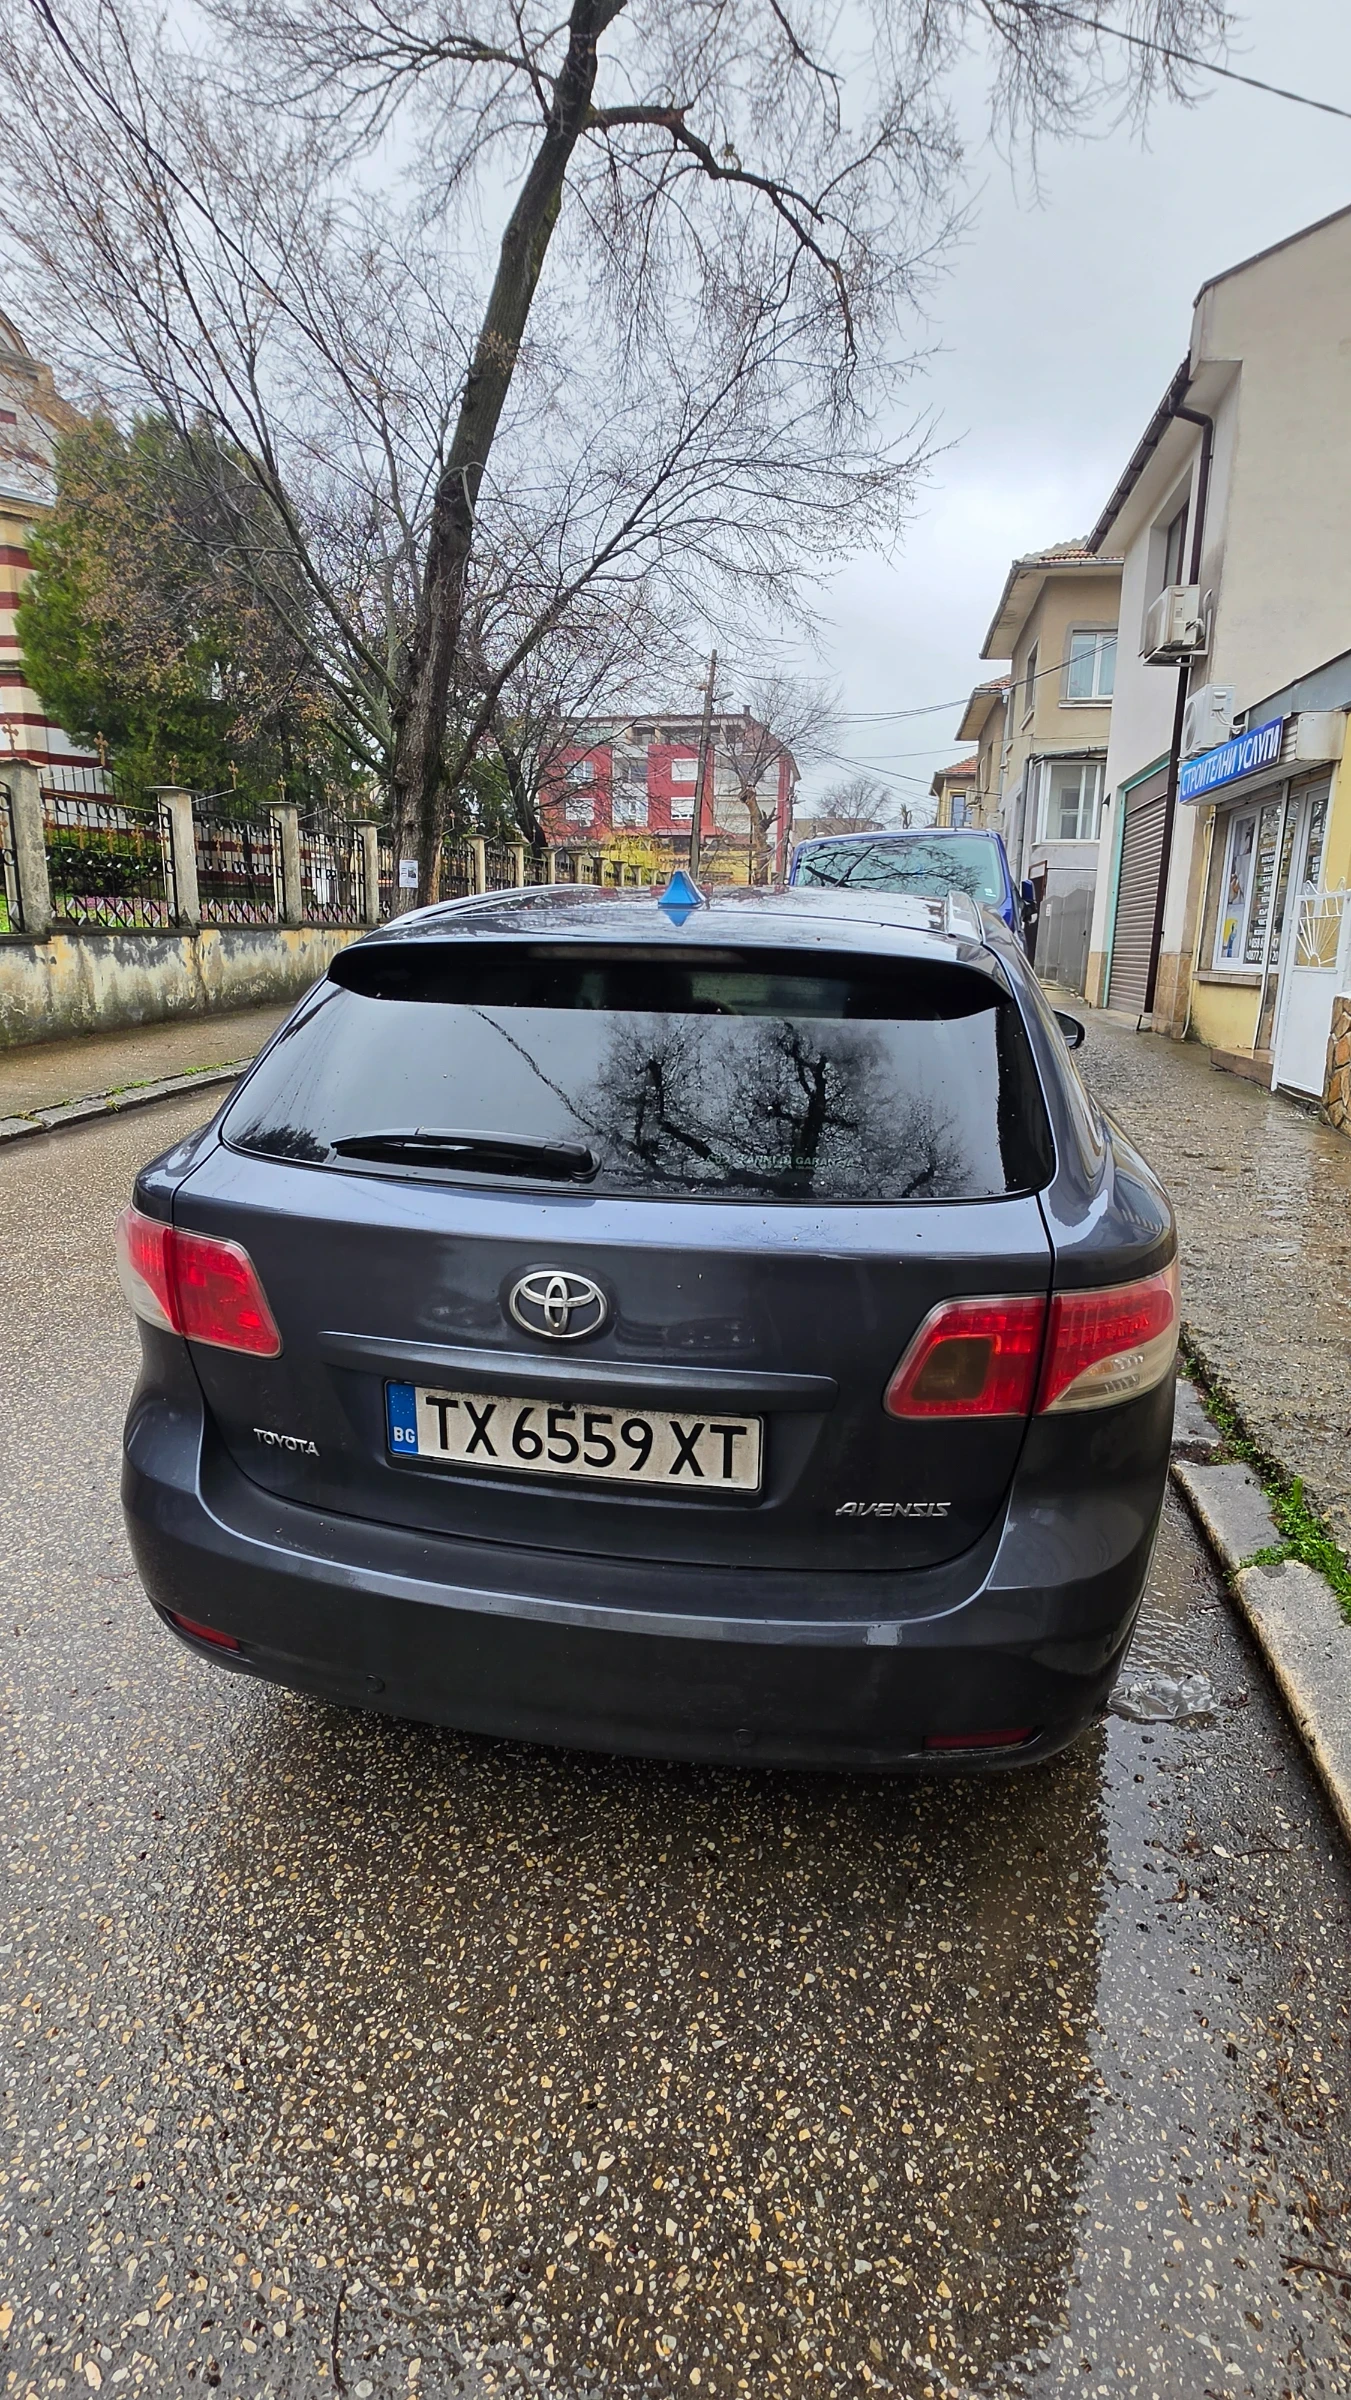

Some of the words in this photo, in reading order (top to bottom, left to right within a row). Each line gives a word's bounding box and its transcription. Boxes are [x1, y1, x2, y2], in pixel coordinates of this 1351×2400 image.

[1182, 744, 1238, 796] СТРОИТЕЛНИ
[1237, 725, 1280, 772] УСЛУГИ
[253, 1428, 320, 1456] TOYOTA
[393, 1426, 416, 1444] BG
[425, 1396, 498, 1457] TX
[511, 1406, 654, 1471] 6559
[668, 1420, 748, 1479] XT
[835, 1502, 951, 1517] AVENSIS
